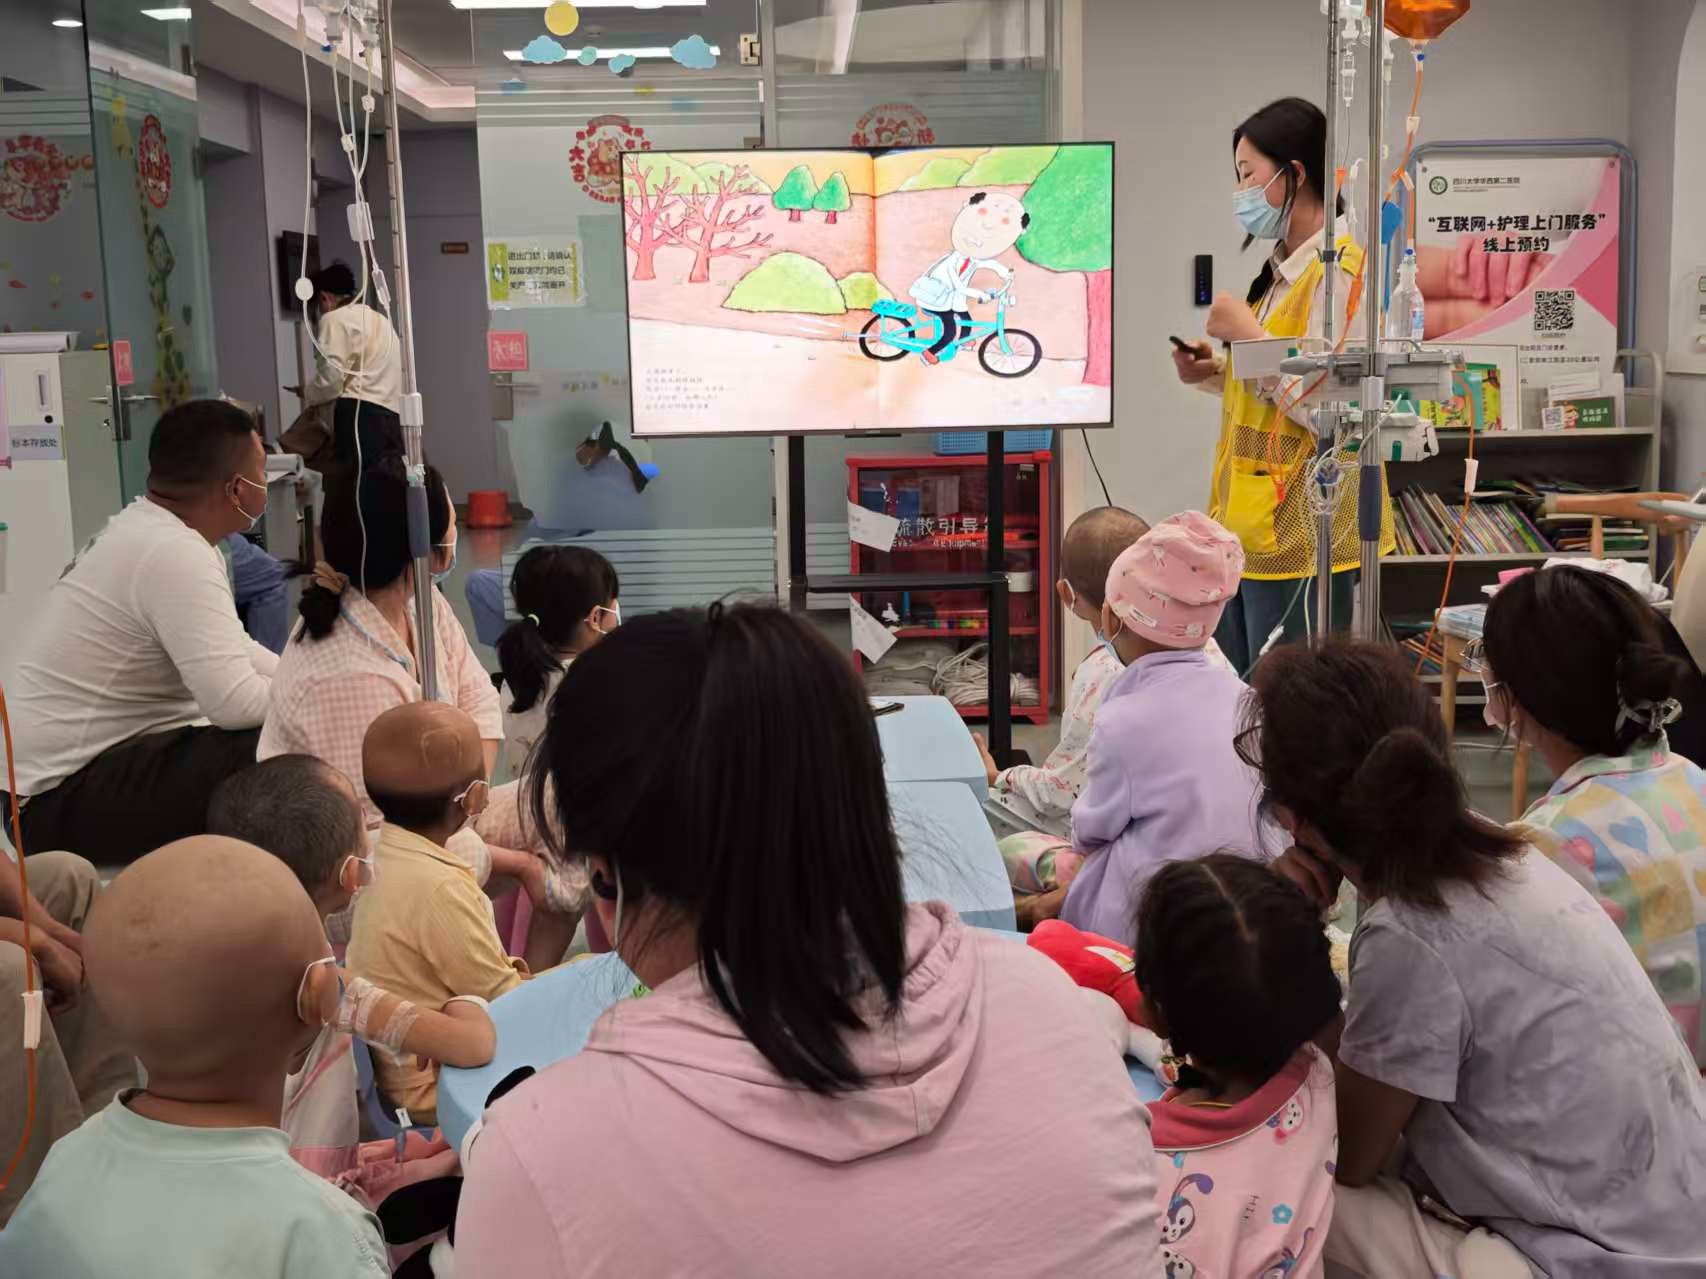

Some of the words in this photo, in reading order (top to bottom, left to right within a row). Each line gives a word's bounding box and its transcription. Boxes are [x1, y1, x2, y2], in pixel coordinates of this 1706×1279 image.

[1428, 214, 1606, 232] “互联网+护理上门服务”
[1483, 236, 1550, 252] 线上预约
[897, 517, 988, 537] 疏散引导
